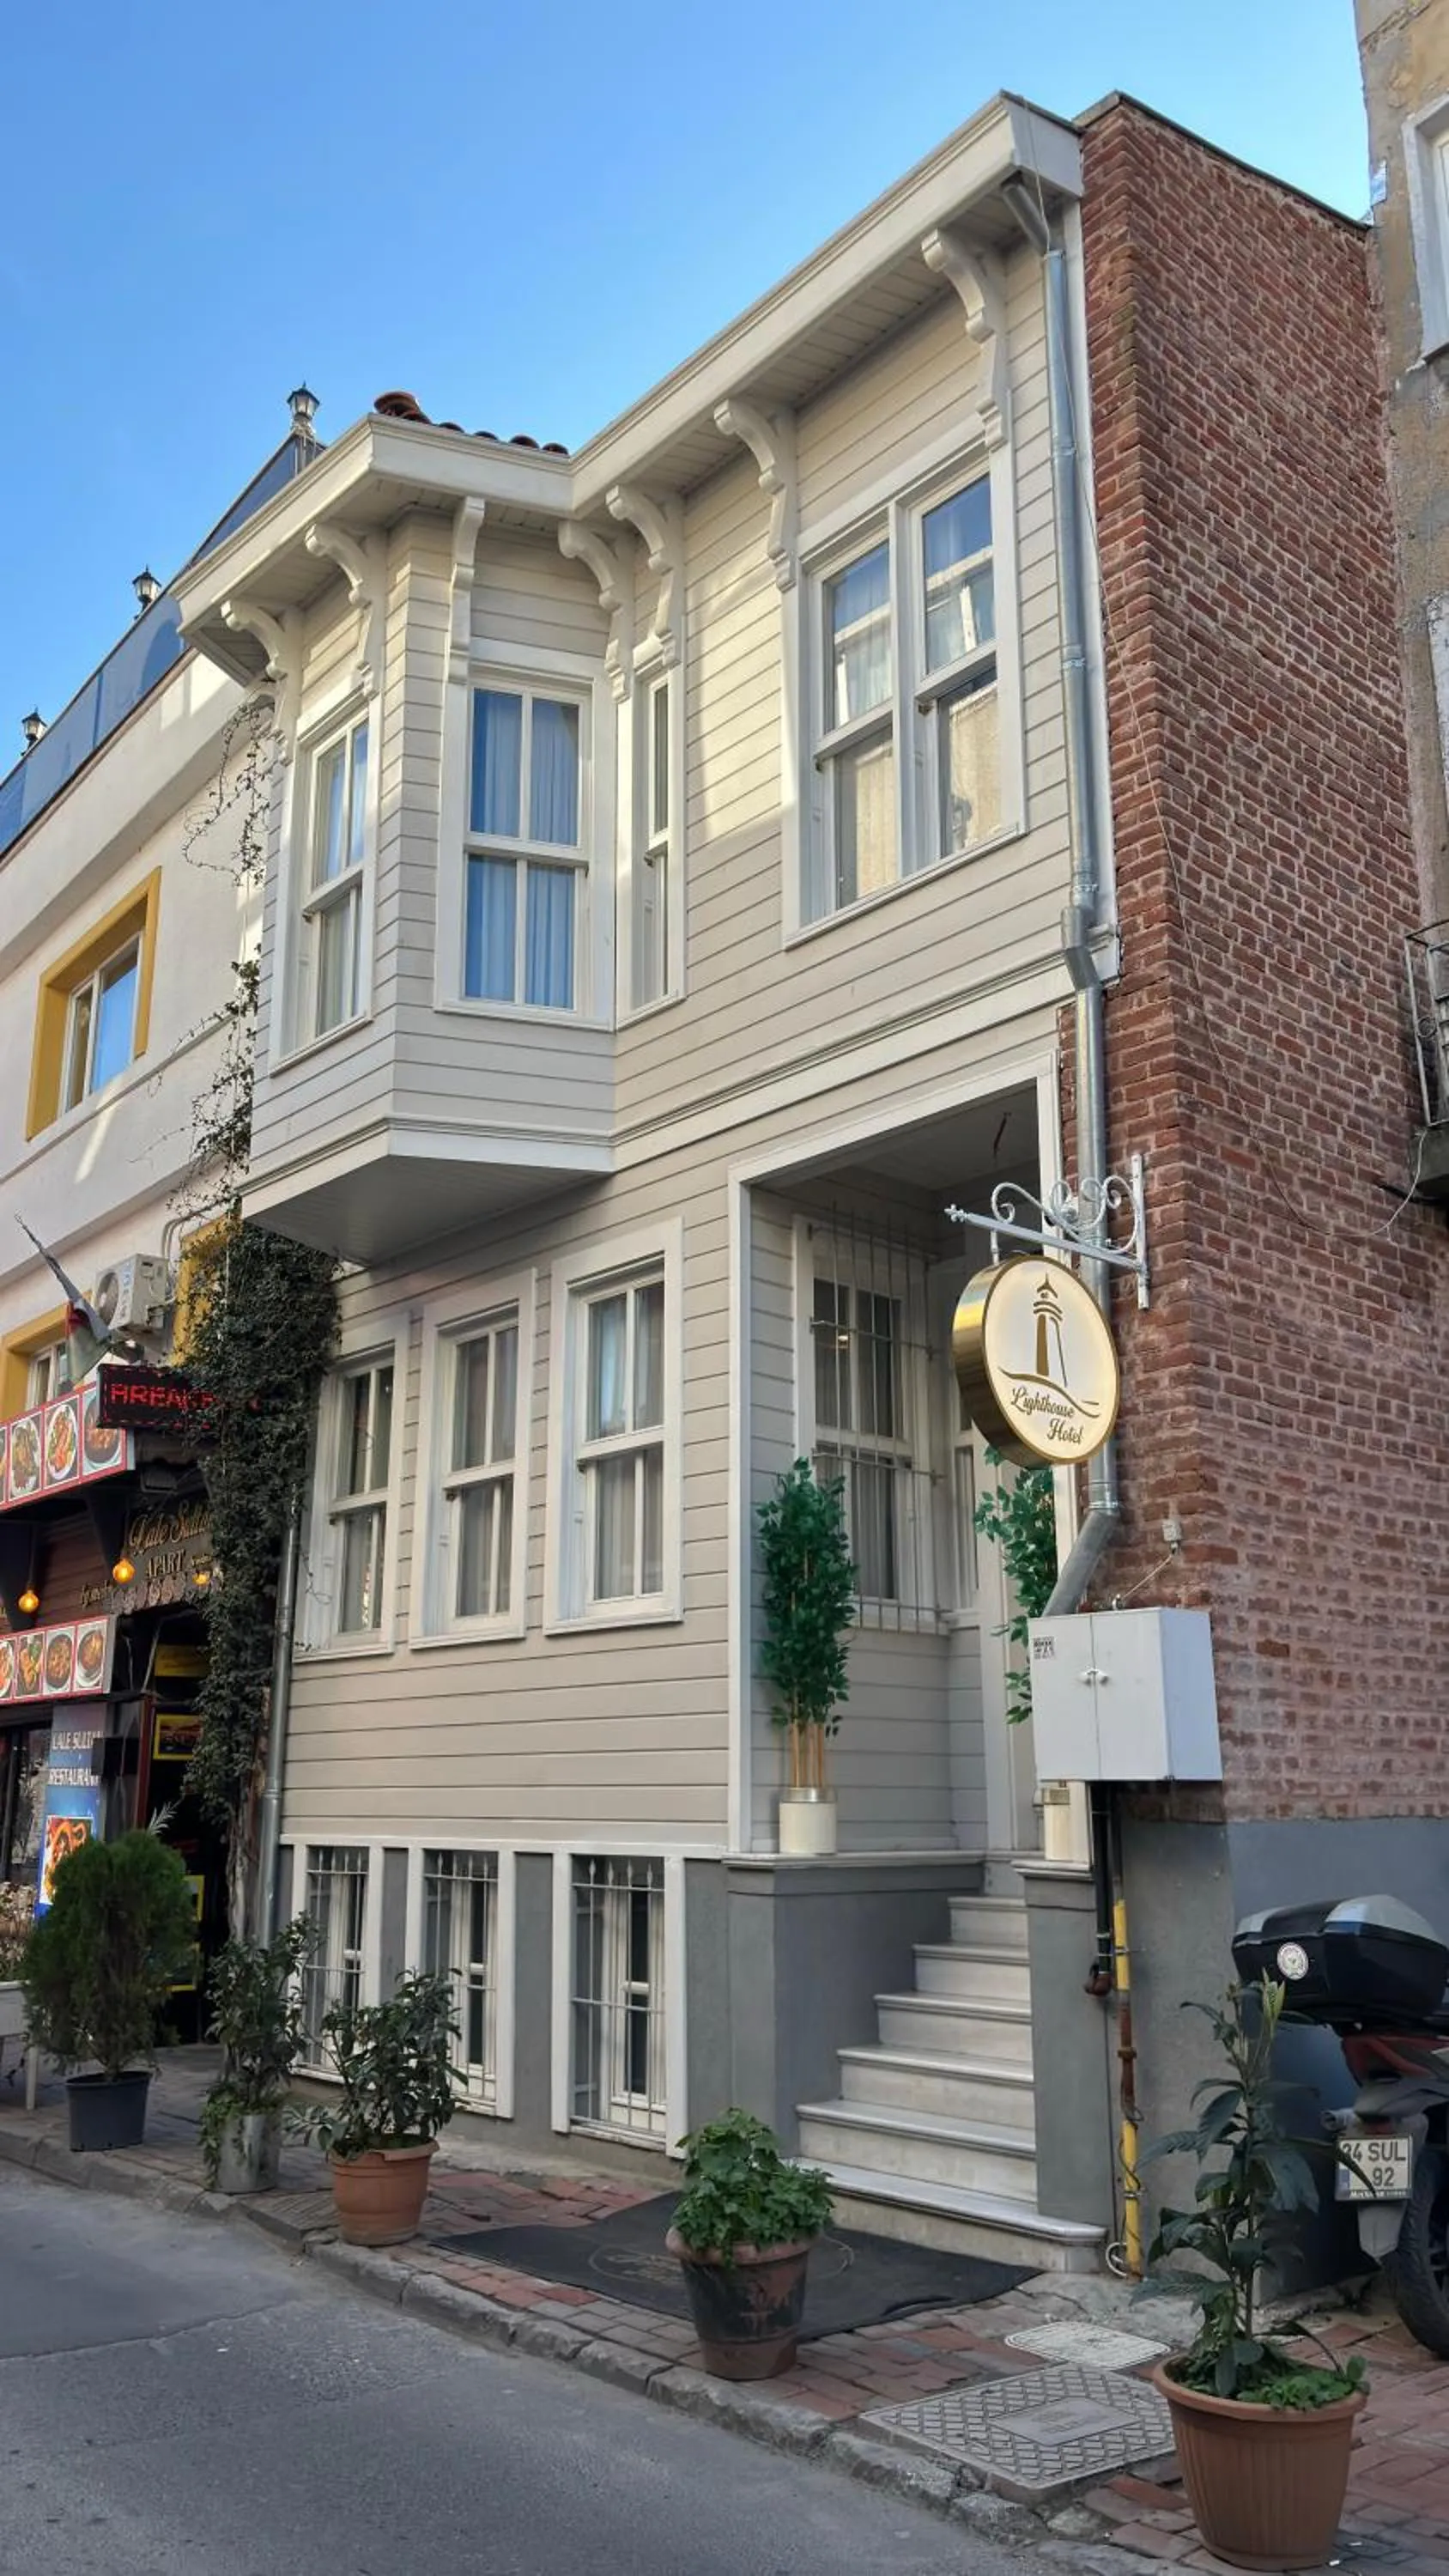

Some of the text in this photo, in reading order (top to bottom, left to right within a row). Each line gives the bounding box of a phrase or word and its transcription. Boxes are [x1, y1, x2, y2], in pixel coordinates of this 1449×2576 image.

[1010, 1386, 1075, 1419] Lighthouse
[1046, 1418, 1084, 1445] Hotel
[146, 1549, 186, 1578] APART
[1367, 2141, 1406, 2162] SUL
[1373, 2166, 1395, 2187] 92
